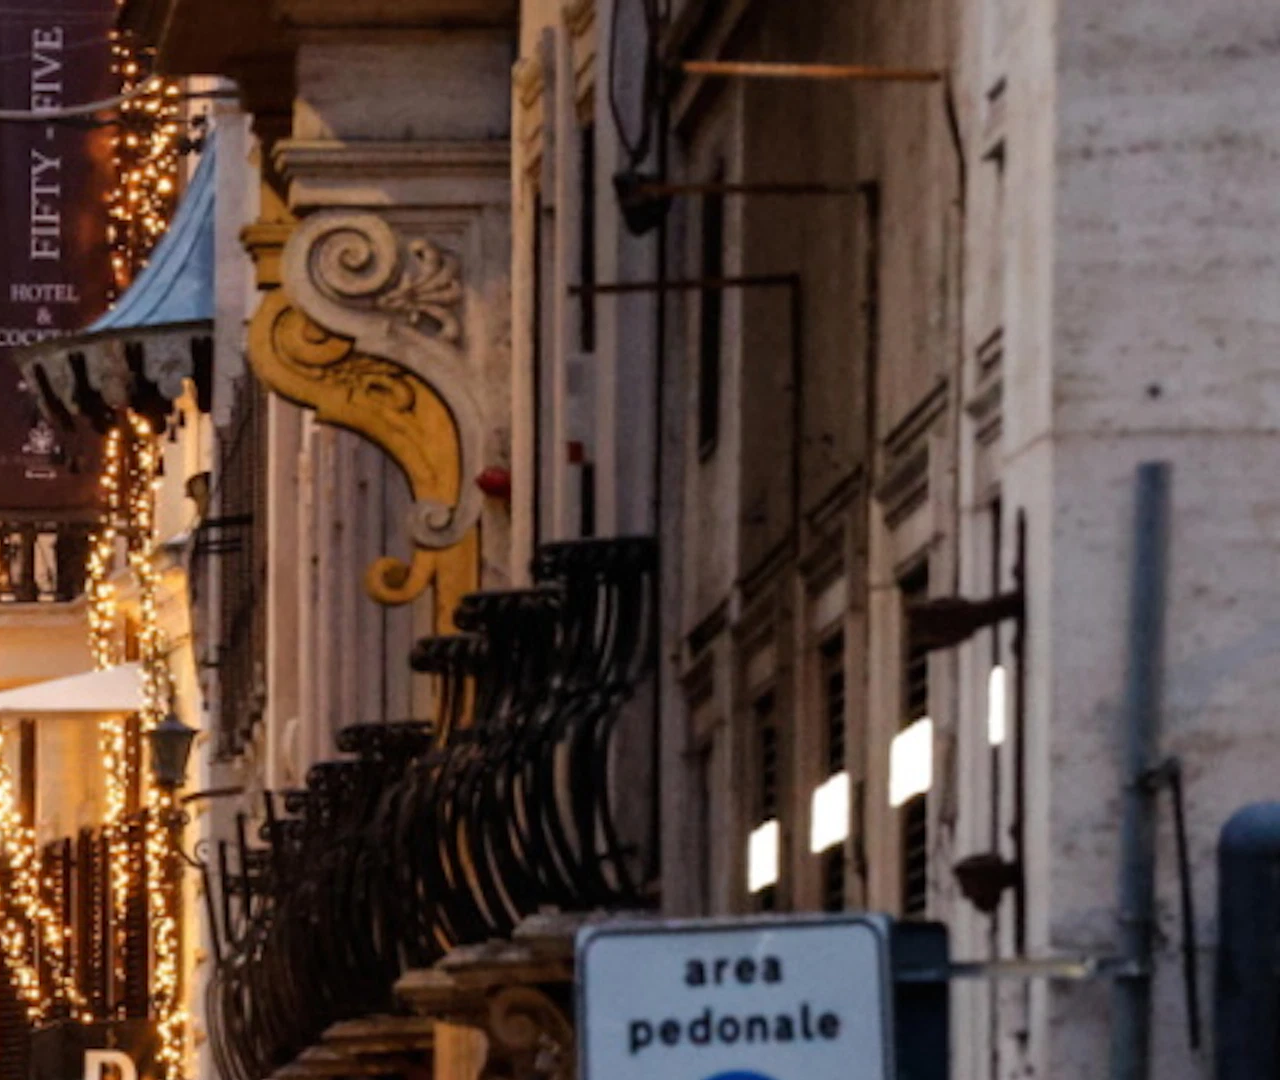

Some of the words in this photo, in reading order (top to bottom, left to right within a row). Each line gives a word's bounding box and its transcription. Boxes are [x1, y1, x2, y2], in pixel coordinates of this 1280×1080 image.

[31, 25, 63, 115] FIVE
[30, 149, 61, 260] FIFTY
[9, 283, 81, 301] HOTEL
[36, 307, 53, 325] &
[683, 954, 785, 988] area
[628, 1002, 841, 1056] pedonale
